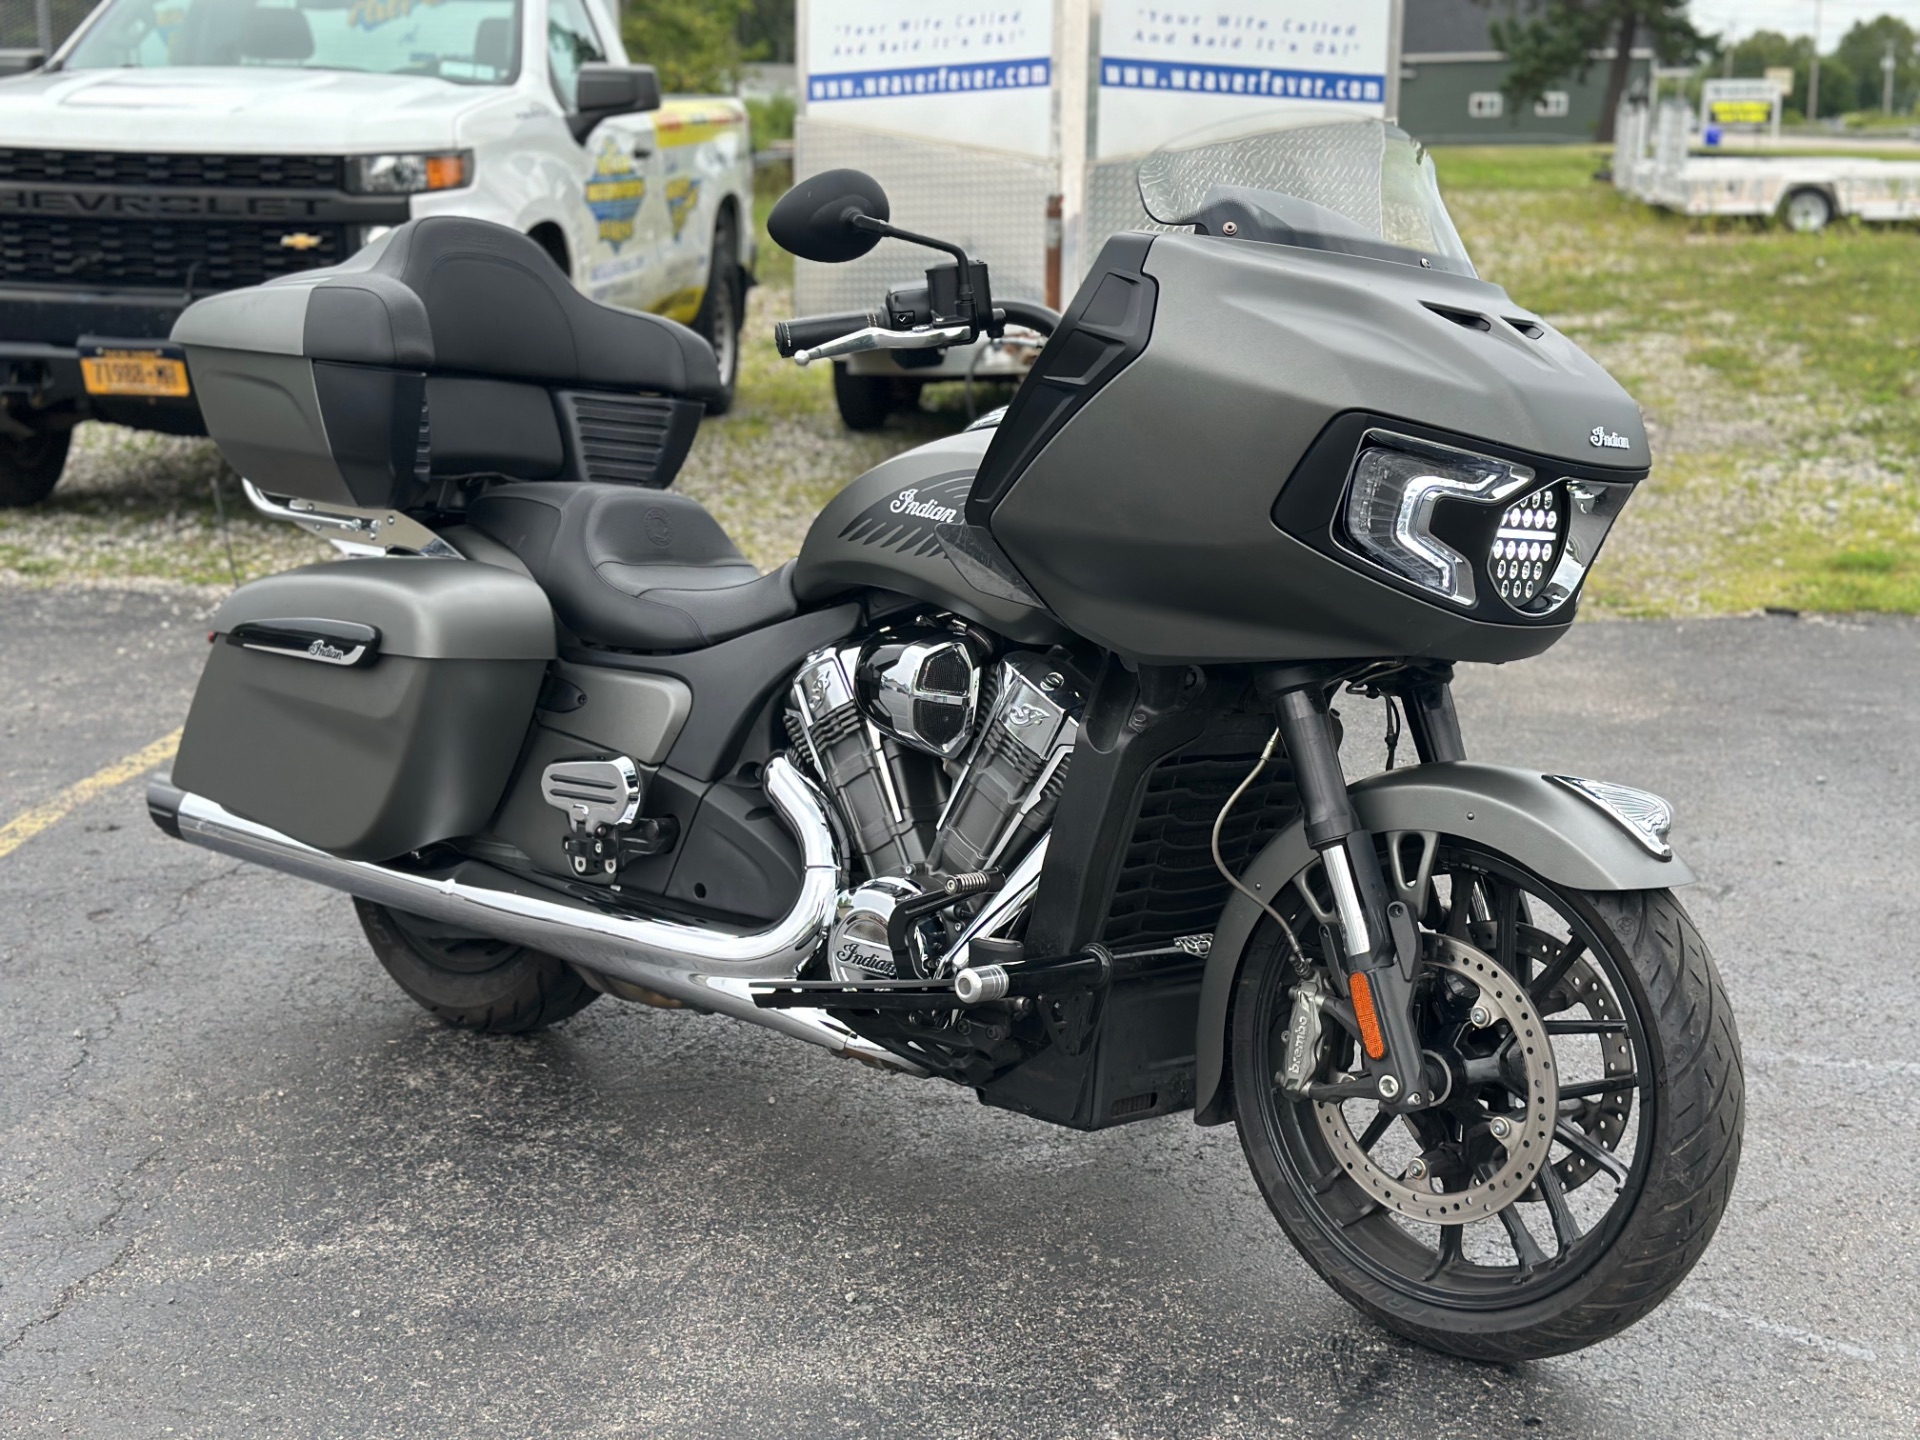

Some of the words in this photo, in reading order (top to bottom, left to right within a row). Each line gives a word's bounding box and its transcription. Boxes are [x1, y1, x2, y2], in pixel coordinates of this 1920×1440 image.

[811, 65, 1048, 100] www.weaverfever.com
[1104, 64, 1381, 101] www.weaverfever.com
[1590, 426, 1630, 449] Indian
[889, 488, 957, 523] Indian
[308, 639, 344, 660] Indian
[836, 943, 897, 976] Indian
[1288, 1015, 1307, 1074] brembo
